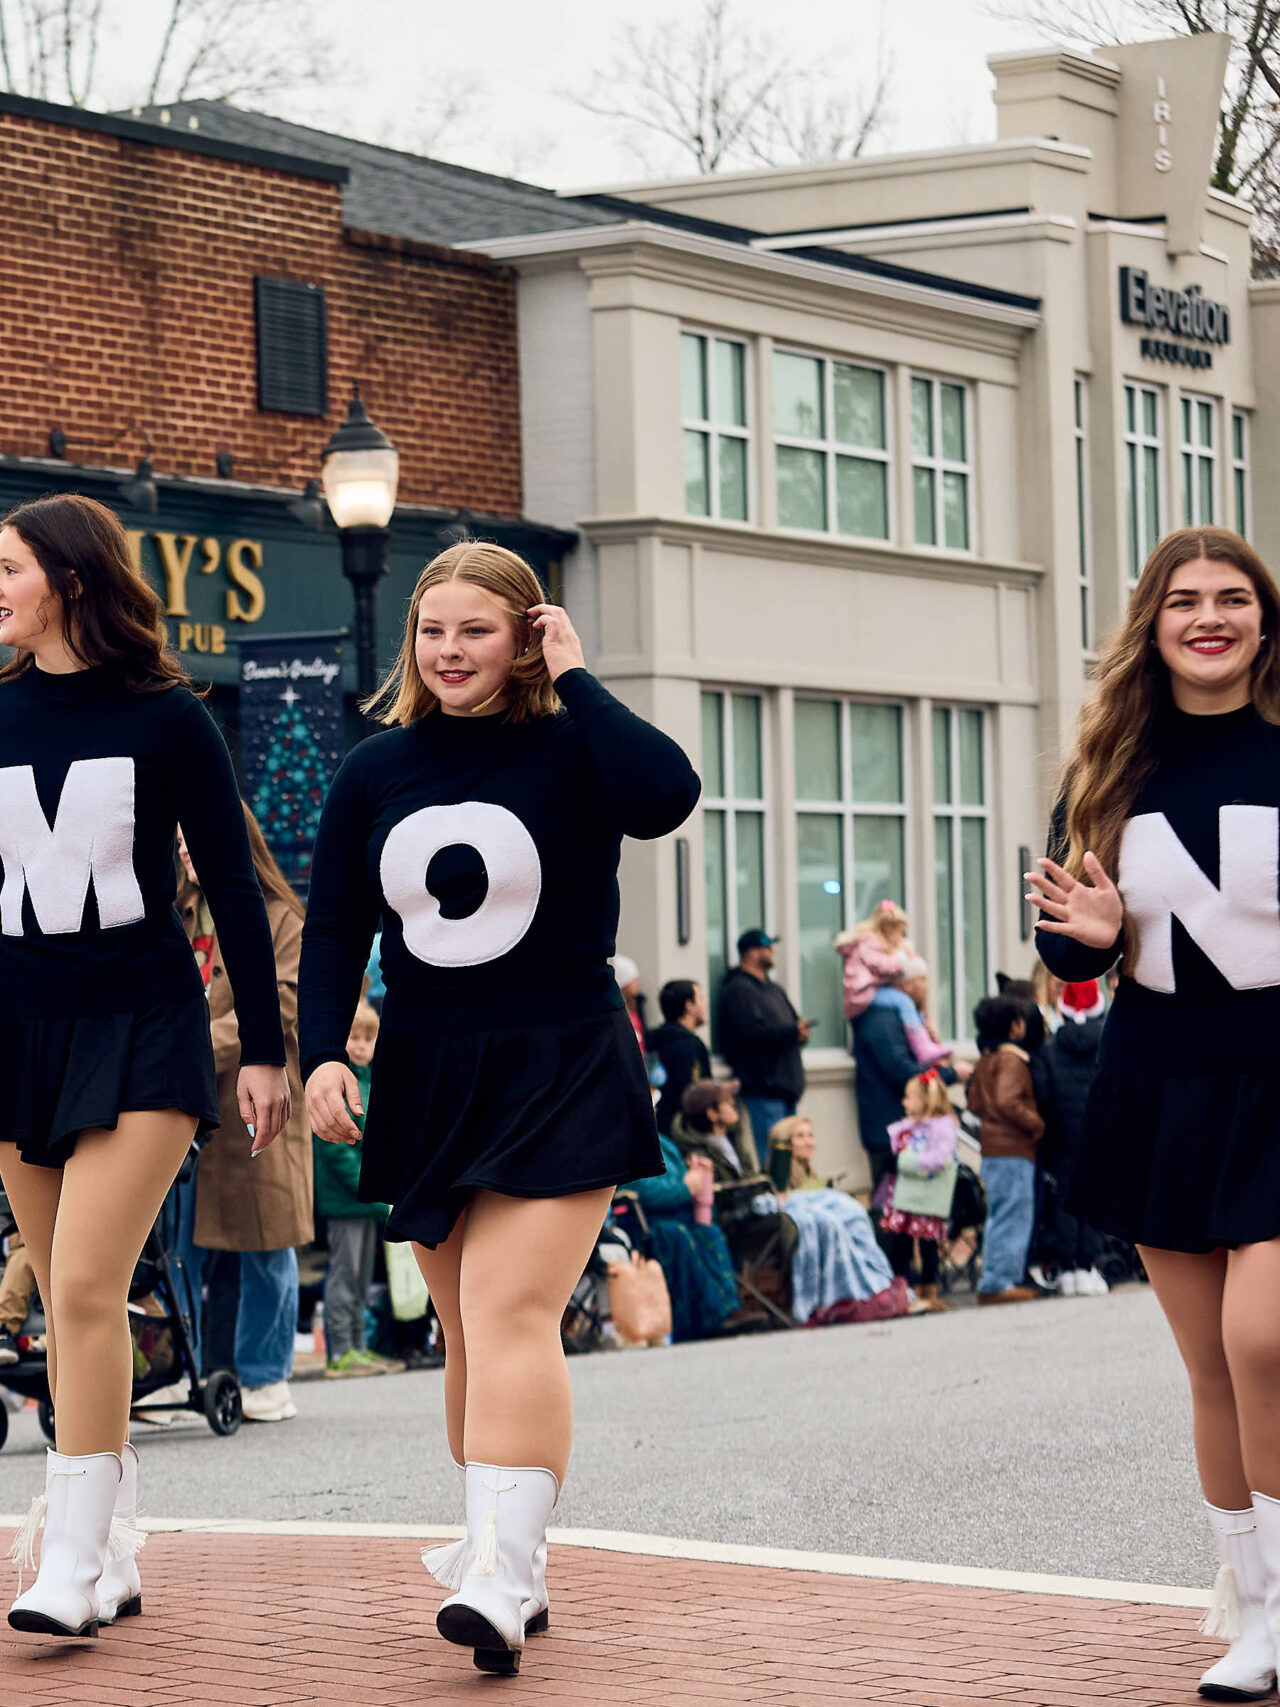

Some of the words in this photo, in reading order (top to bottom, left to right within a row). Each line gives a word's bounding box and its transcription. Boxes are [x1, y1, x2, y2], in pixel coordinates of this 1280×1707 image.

[1153, 76, 1172, 173] IRIS
[1119, 265, 1230, 345] Elevation
[178, 622, 227, 654] PUB
[380, 801, 542, 968] O
[1118, 804, 1280, 993] N
